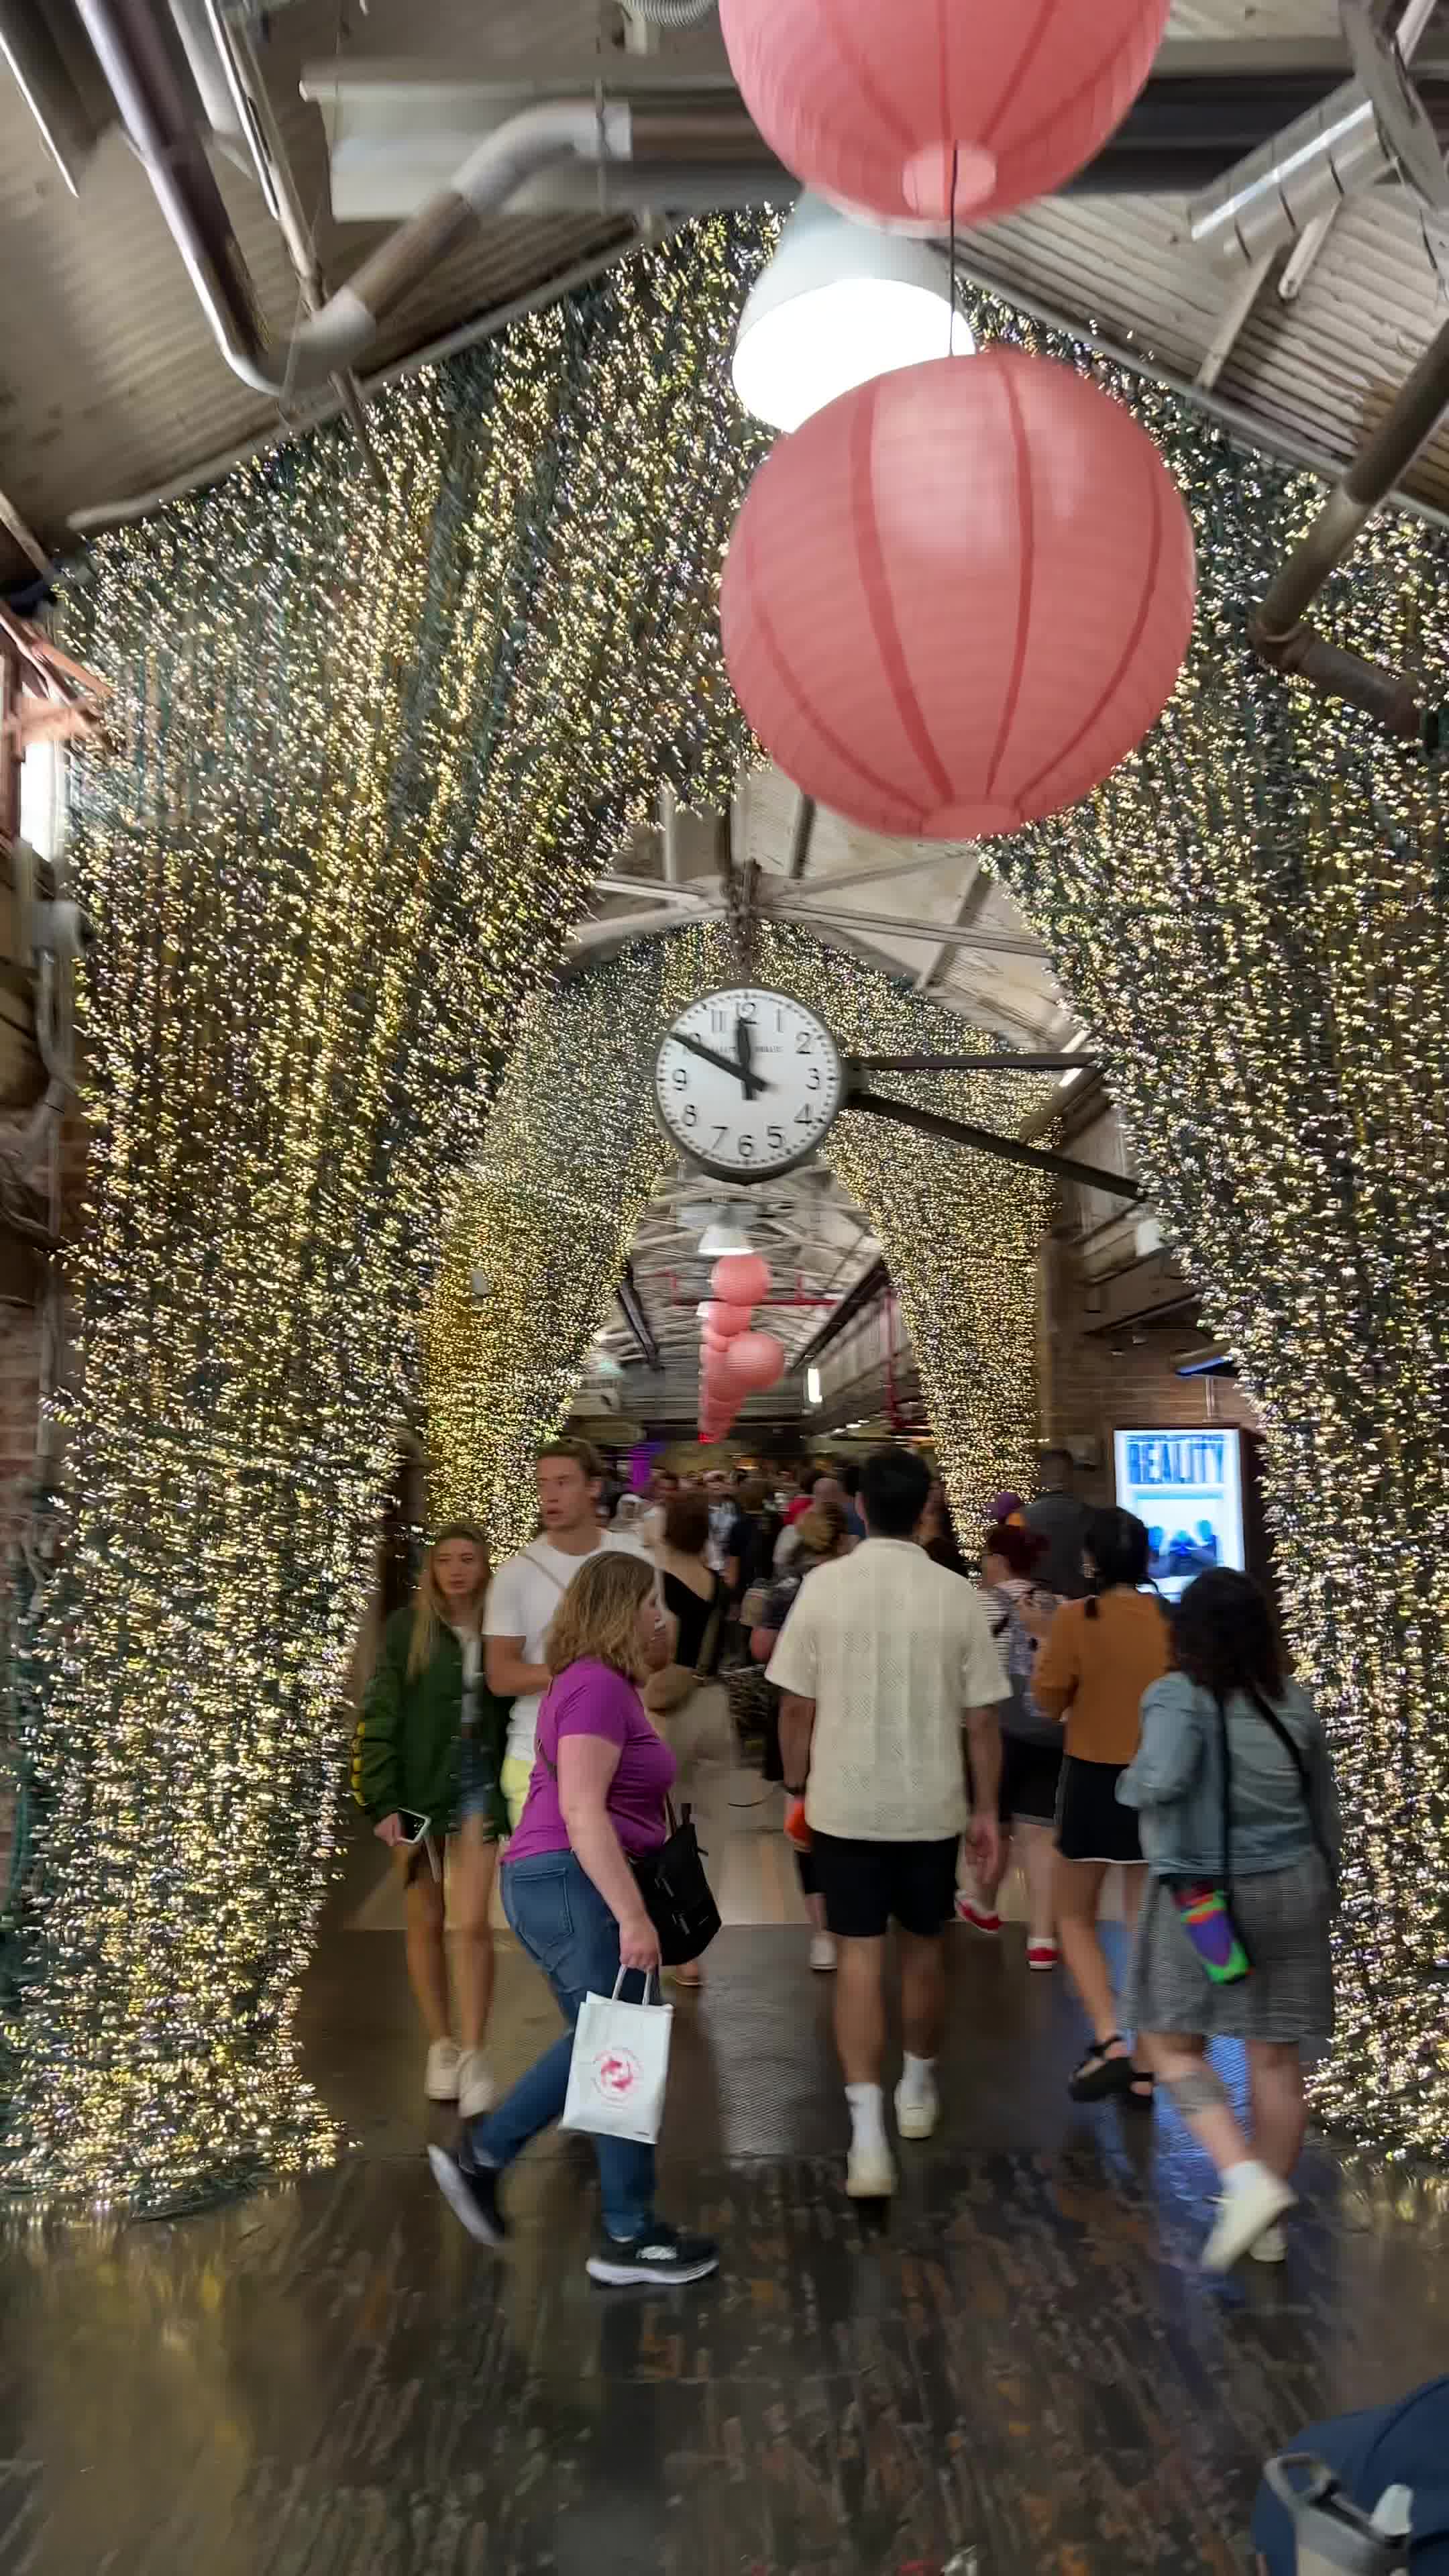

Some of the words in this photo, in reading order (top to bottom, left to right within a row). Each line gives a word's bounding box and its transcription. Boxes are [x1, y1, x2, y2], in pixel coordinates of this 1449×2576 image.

[710, 1008, 727, 1033] 11
[776, 1008, 784, 1033] 1
[796, 1031, 812, 1055] 2
[672, 1068, 688, 1091] 9
[805, 1067, 821, 1090] 3
[682, 1104, 698, 1127] 8
[794, 1104, 813, 1124] 4
[711, 1126, 729, 1150] 7
[739, 1134, 755, 1158] 6
[767, 1126, 784, 1149] 5
